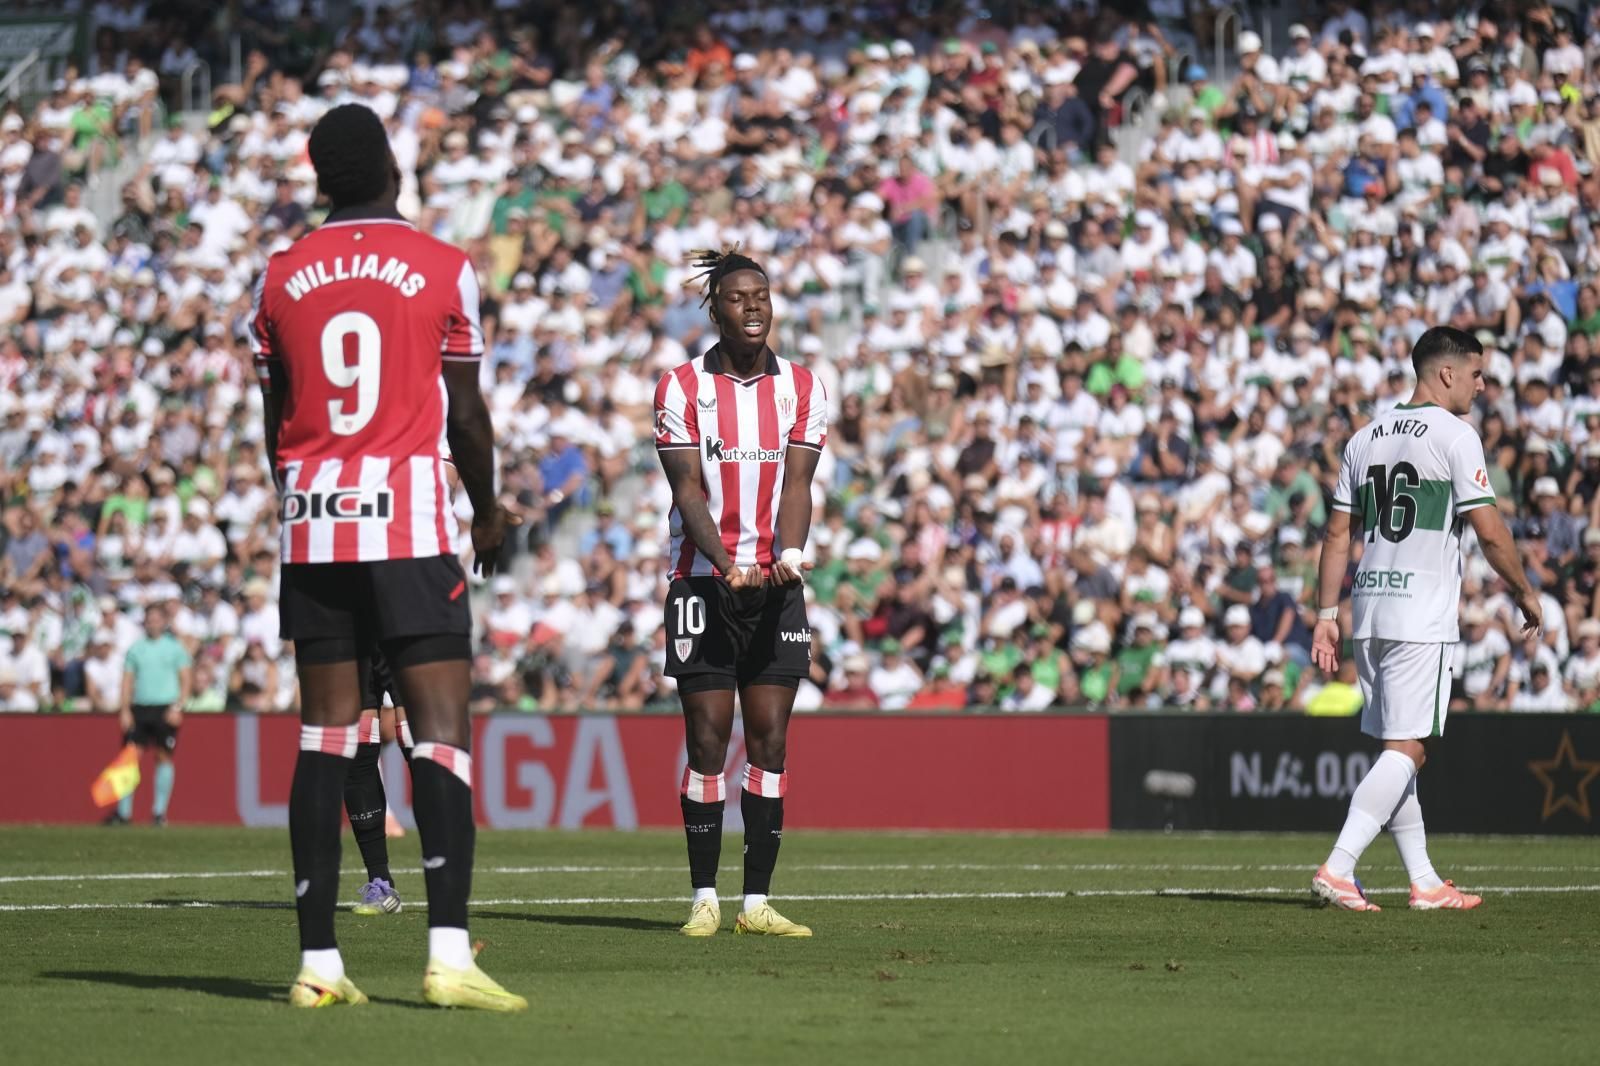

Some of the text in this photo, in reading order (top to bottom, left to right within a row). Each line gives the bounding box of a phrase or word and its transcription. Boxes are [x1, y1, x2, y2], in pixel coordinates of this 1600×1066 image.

[284, 253, 426, 302] WILLIAMS
[320, 311, 382, 436] 9
[1370, 419, 1429, 442] M. NETO
[282, 491, 389, 522] DIGI
[1365, 460, 1421, 544] 16
[674, 595, 706, 635] 10
